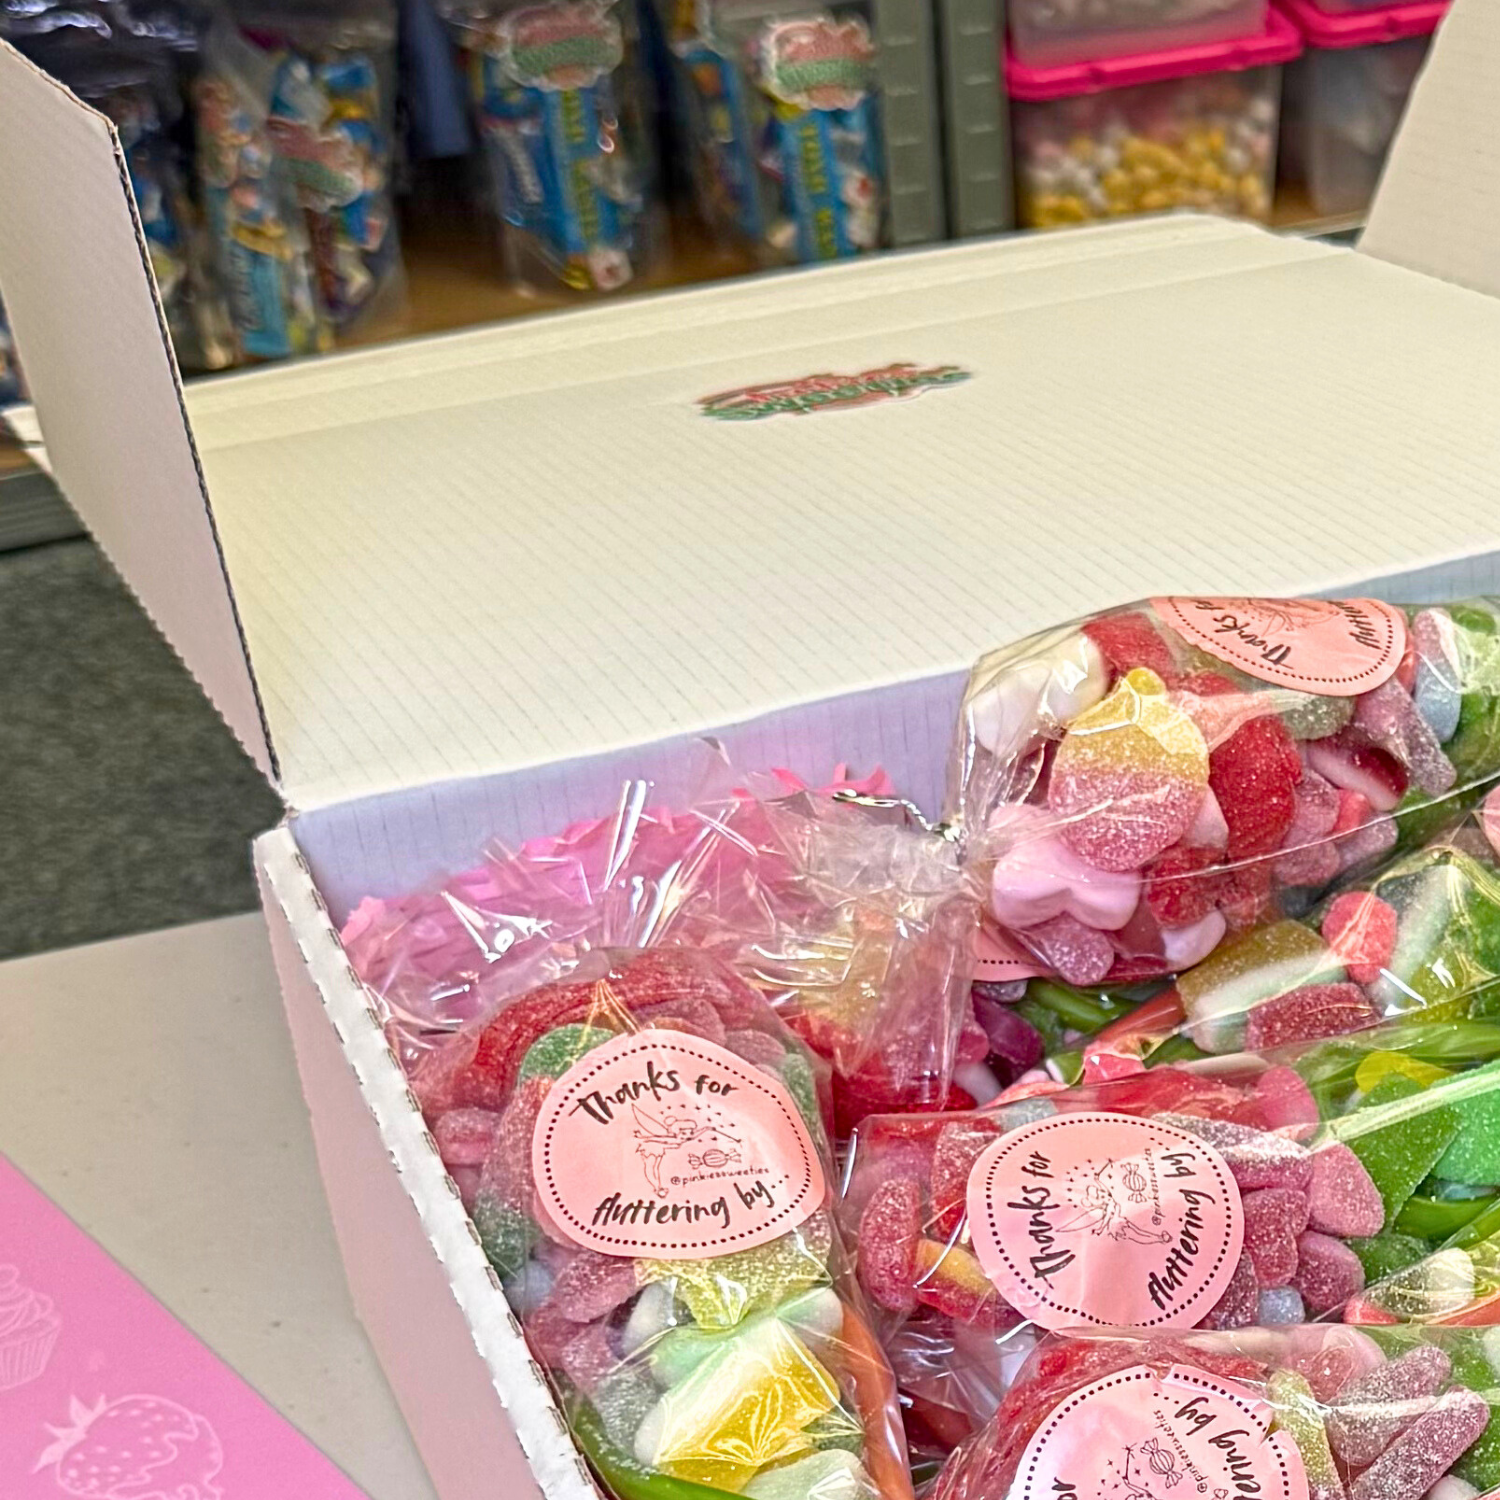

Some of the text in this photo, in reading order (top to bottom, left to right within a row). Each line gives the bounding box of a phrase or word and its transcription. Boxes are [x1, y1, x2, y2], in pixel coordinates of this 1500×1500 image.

[1213, 615, 1293, 669] Thanks
[569, 1062, 739, 1124] Thanks for
[592, 1192, 731, 1228] fluttering
[1007, 1151, 1075, 1289] Thanks for
[1148, 1189, 1215, 1310] fluttering
